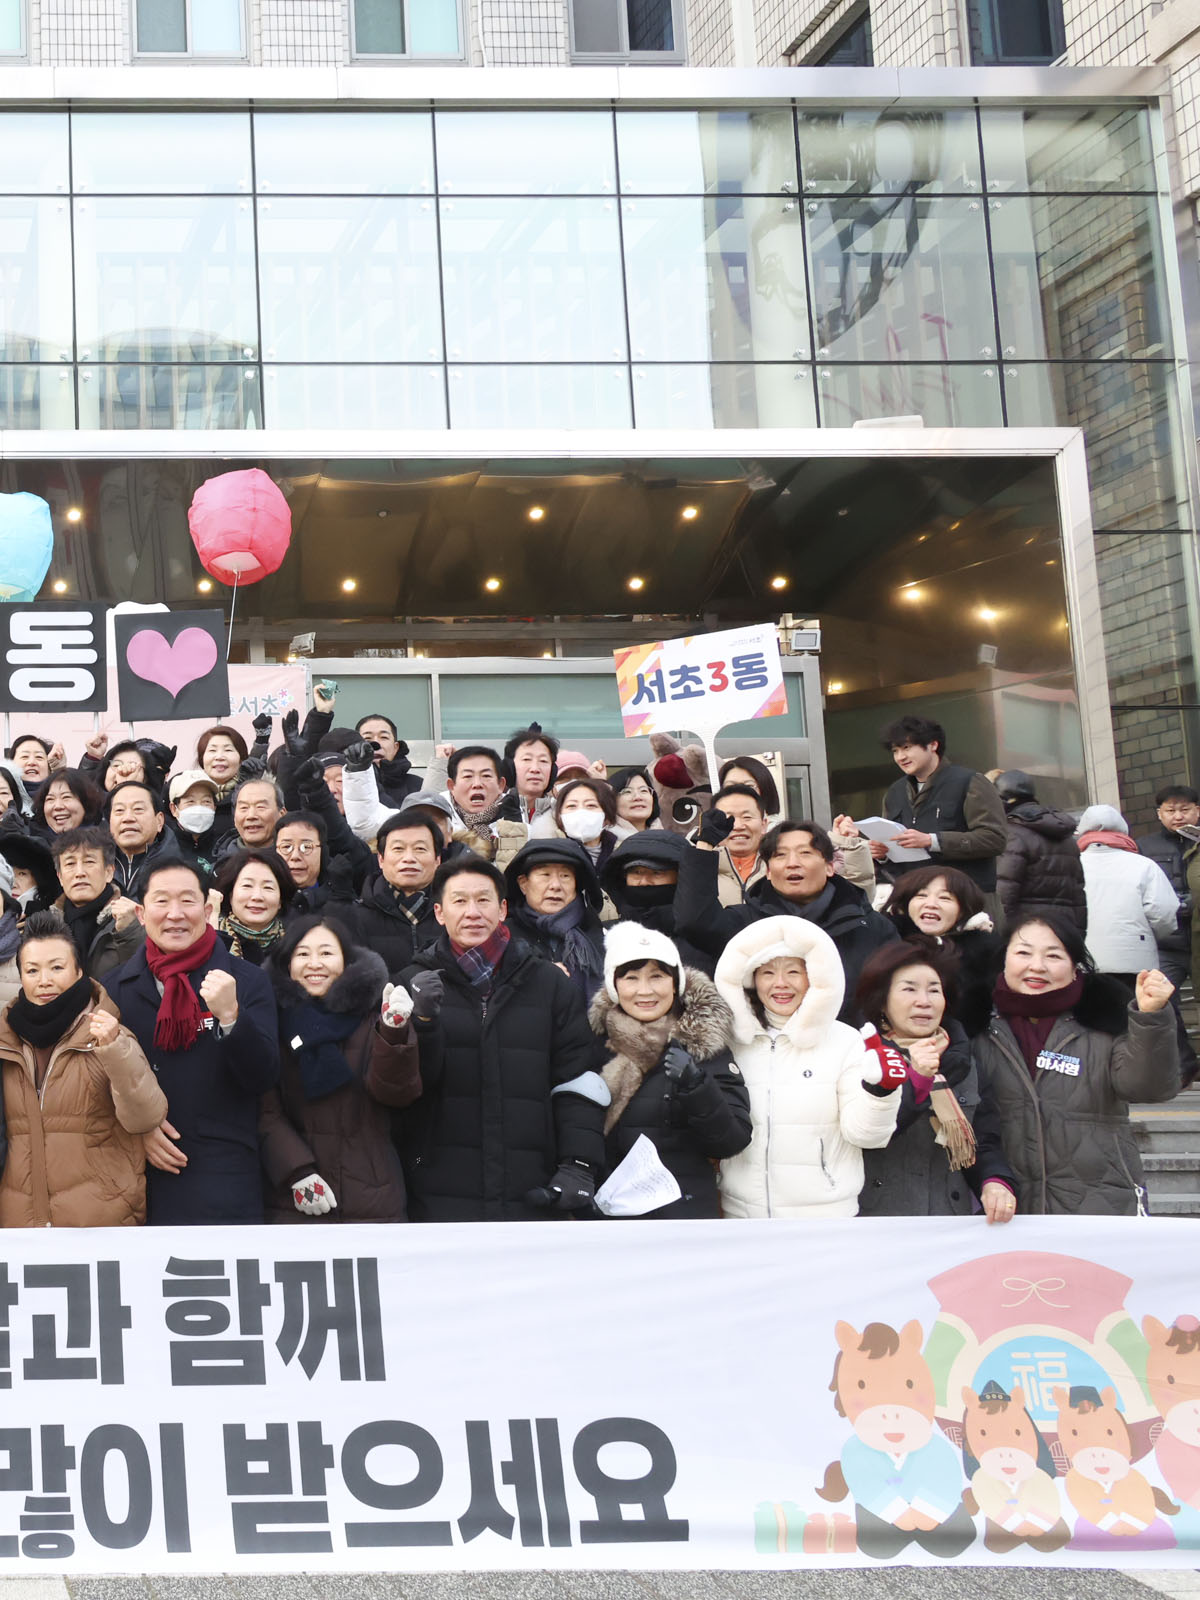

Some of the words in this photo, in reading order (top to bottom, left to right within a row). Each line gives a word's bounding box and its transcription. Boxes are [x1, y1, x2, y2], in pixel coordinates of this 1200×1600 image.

[6, 612, 97, 701] 동
[632, 652, 768, 705] 서초3동
[163, 1257, 385, 1386] 함께
[1011, 1352, 1070, 1411] 福
[223, 1418, 689, 1553] 받으세요
